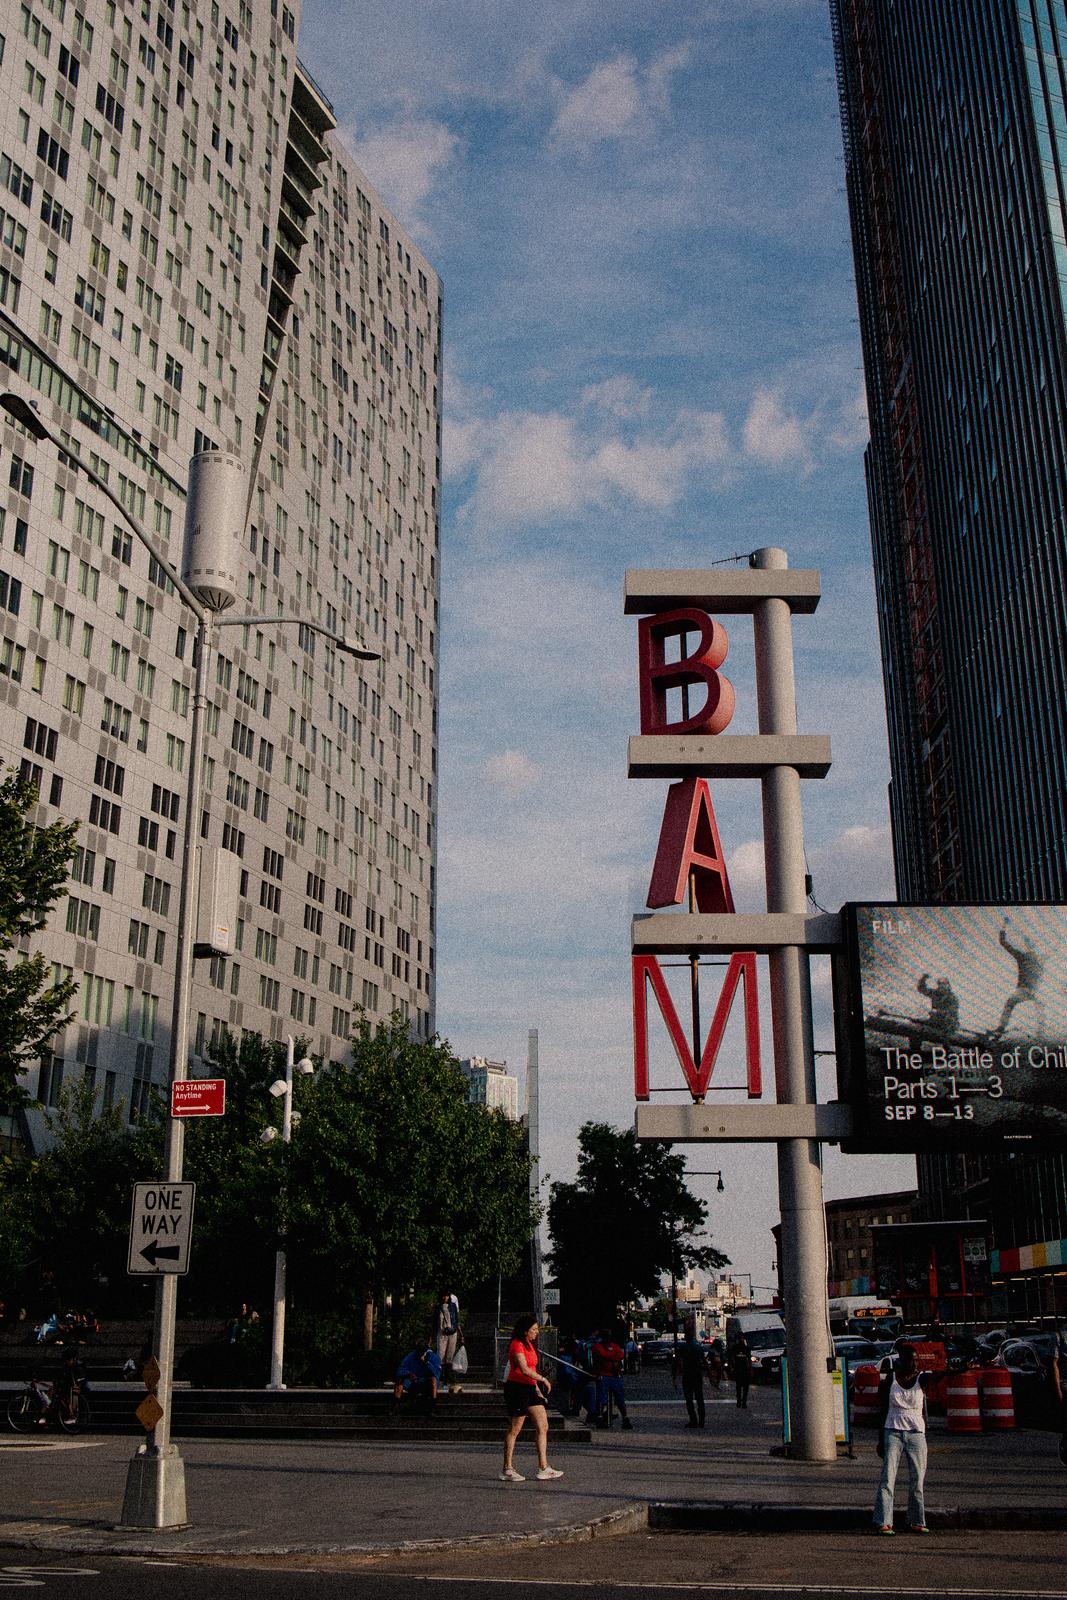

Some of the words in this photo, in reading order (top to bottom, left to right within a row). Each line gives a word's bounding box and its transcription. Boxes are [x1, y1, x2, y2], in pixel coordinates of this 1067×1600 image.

[632, 607, 763, 1102] BAM
[871, 919, 912, 934] FILM
[880, 1047, 923, 1070] The
[932, 1047, 994, 1070] Battle
[1001, 1047, 1022, 1070] of
[175, 1084, 186, 1092] NO
[186, 1083, 217, 1091] STANDING
[175, 1092, 202, 1100] Anytime
[884, 1076, 938, 1099] Parts
[884, 1105, 917, 1121] SEP
[145, 1190, 183, 1211] ONE
[142, 1214, 183, 1235] WAY
